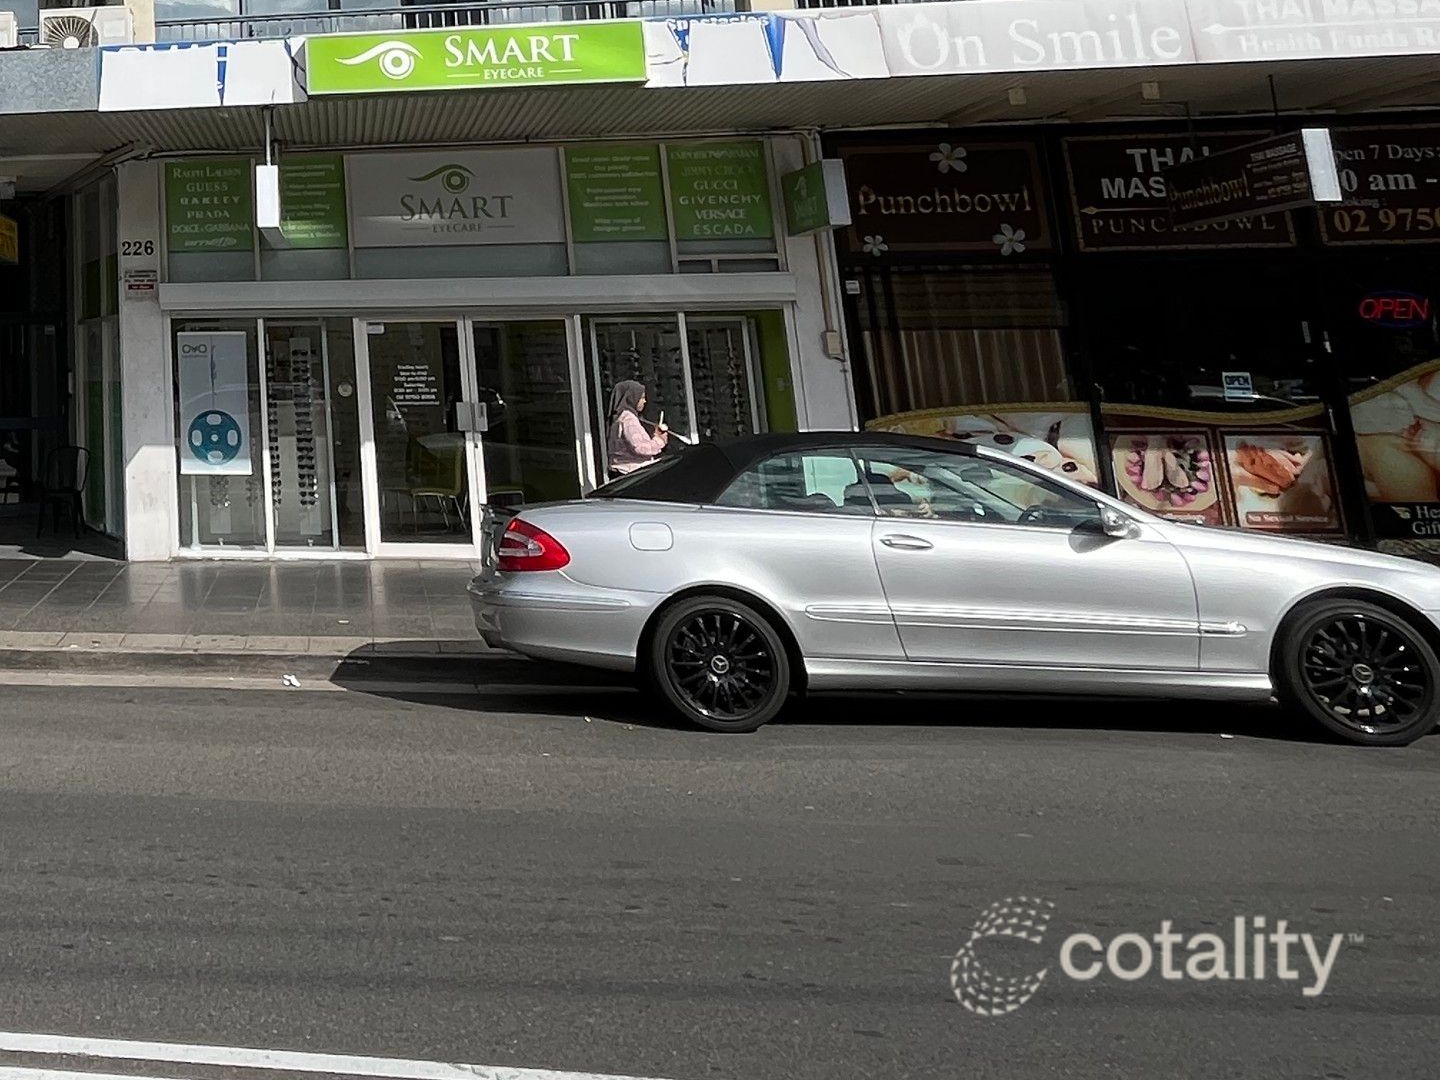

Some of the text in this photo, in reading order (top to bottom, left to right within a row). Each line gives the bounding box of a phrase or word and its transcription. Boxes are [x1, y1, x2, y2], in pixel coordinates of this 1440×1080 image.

[1012, 14, 1182, 65] Smile
[444, 34, 580, 69] SMART
[483, 66, 545, 81] EYECARE
[1368, 144, 1380, 160] 7
[1386, 144, 1435, 162] Days
[186, 182, 228, 192] GUESS
[693, 180, 738, 190] GUCCI
[1368, 173, 1418, 191] am
[180, 196, 240, 205] OAKLEY
[680, 194, 761, 205] GIVENCHY
[858, 185, 1032, 215] Punchbowl
[187, 210, 230, 219] PRADA
[400, 194, 513, 221] SMART
[695, 209, 747, 220] VERSACE
[433, 224, 482, 232] EYECARE
[1334, 209, 1370, 233] 02
[693, 224, 754, 235] ESCADA
[122, 240, 154, 256] 226
[1358, 298, 1429, 320] OPEN
